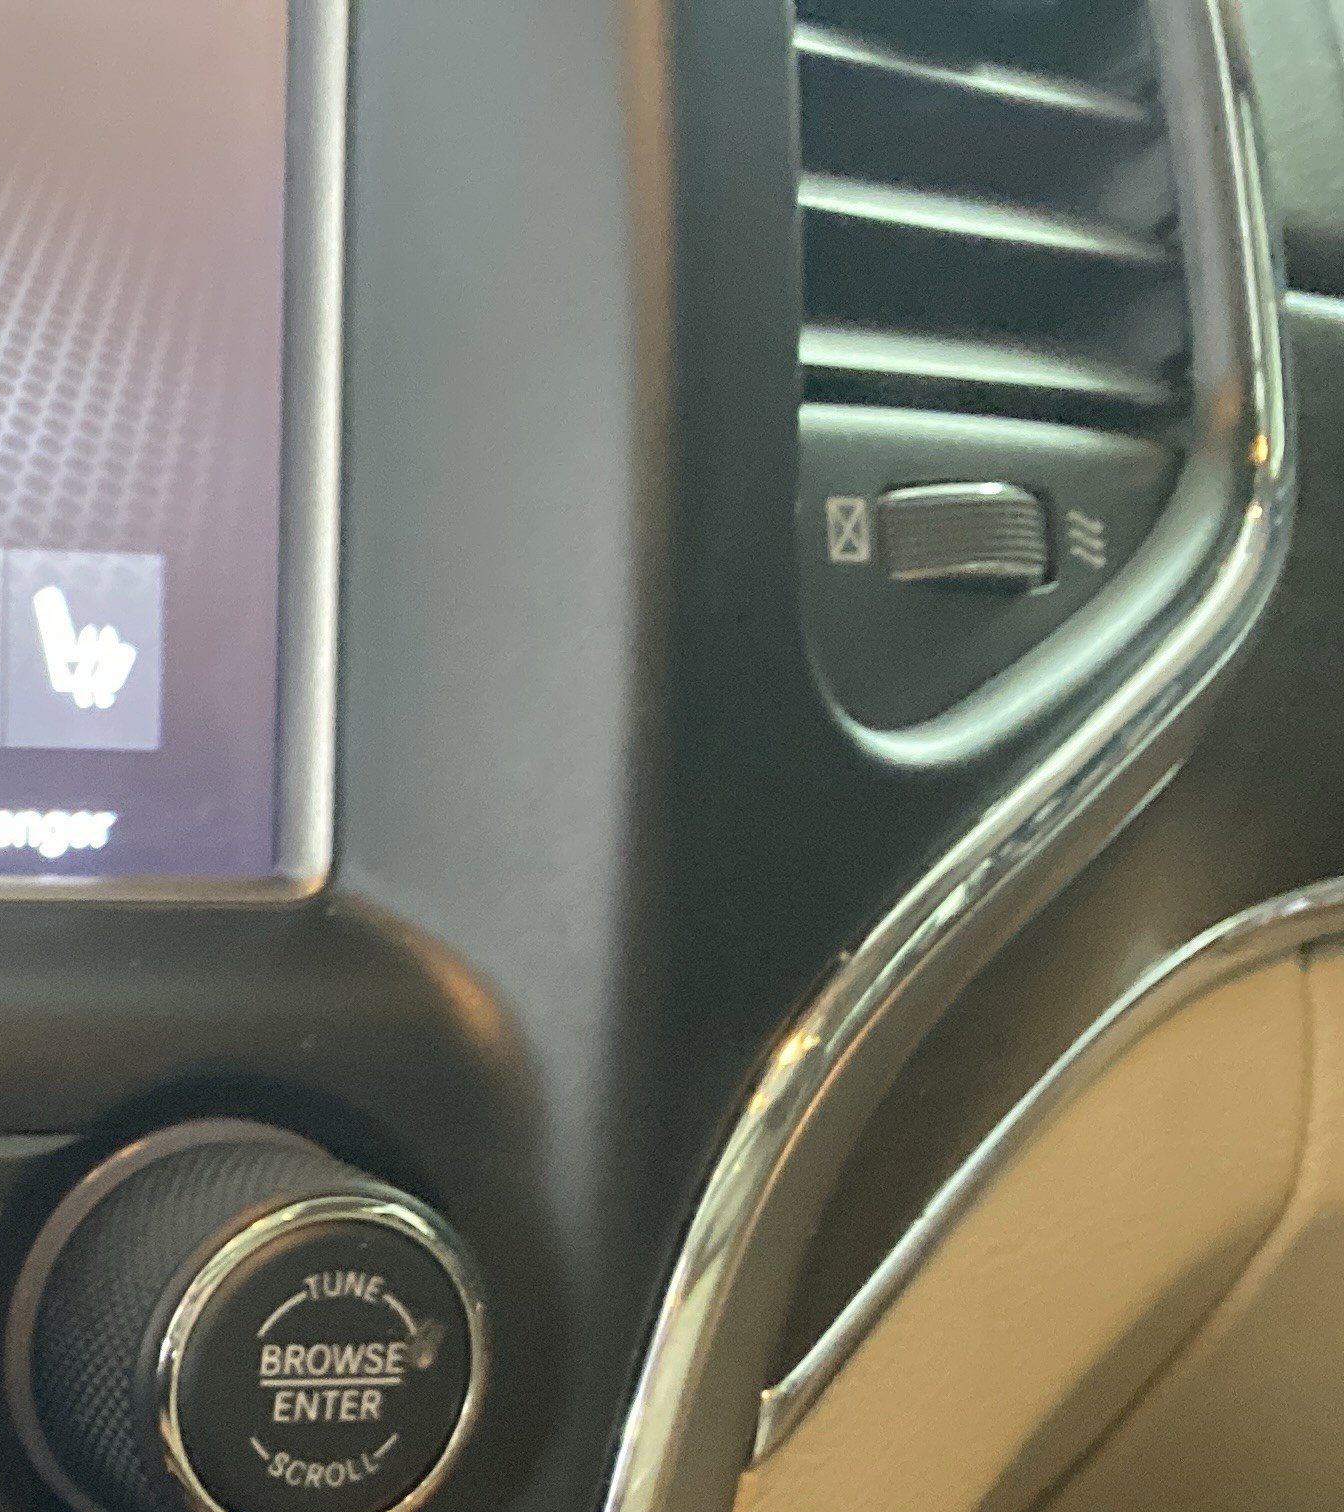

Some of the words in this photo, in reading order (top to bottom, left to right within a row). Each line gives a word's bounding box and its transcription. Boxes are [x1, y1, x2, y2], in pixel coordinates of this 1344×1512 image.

[304, 1271, 385, 1303] TUNE
[261, 1342, 406, 1376] BROWSE
[272, 1389, 382, 1422] ENTER
[268, 1451, 379, 1488] SCROLL
